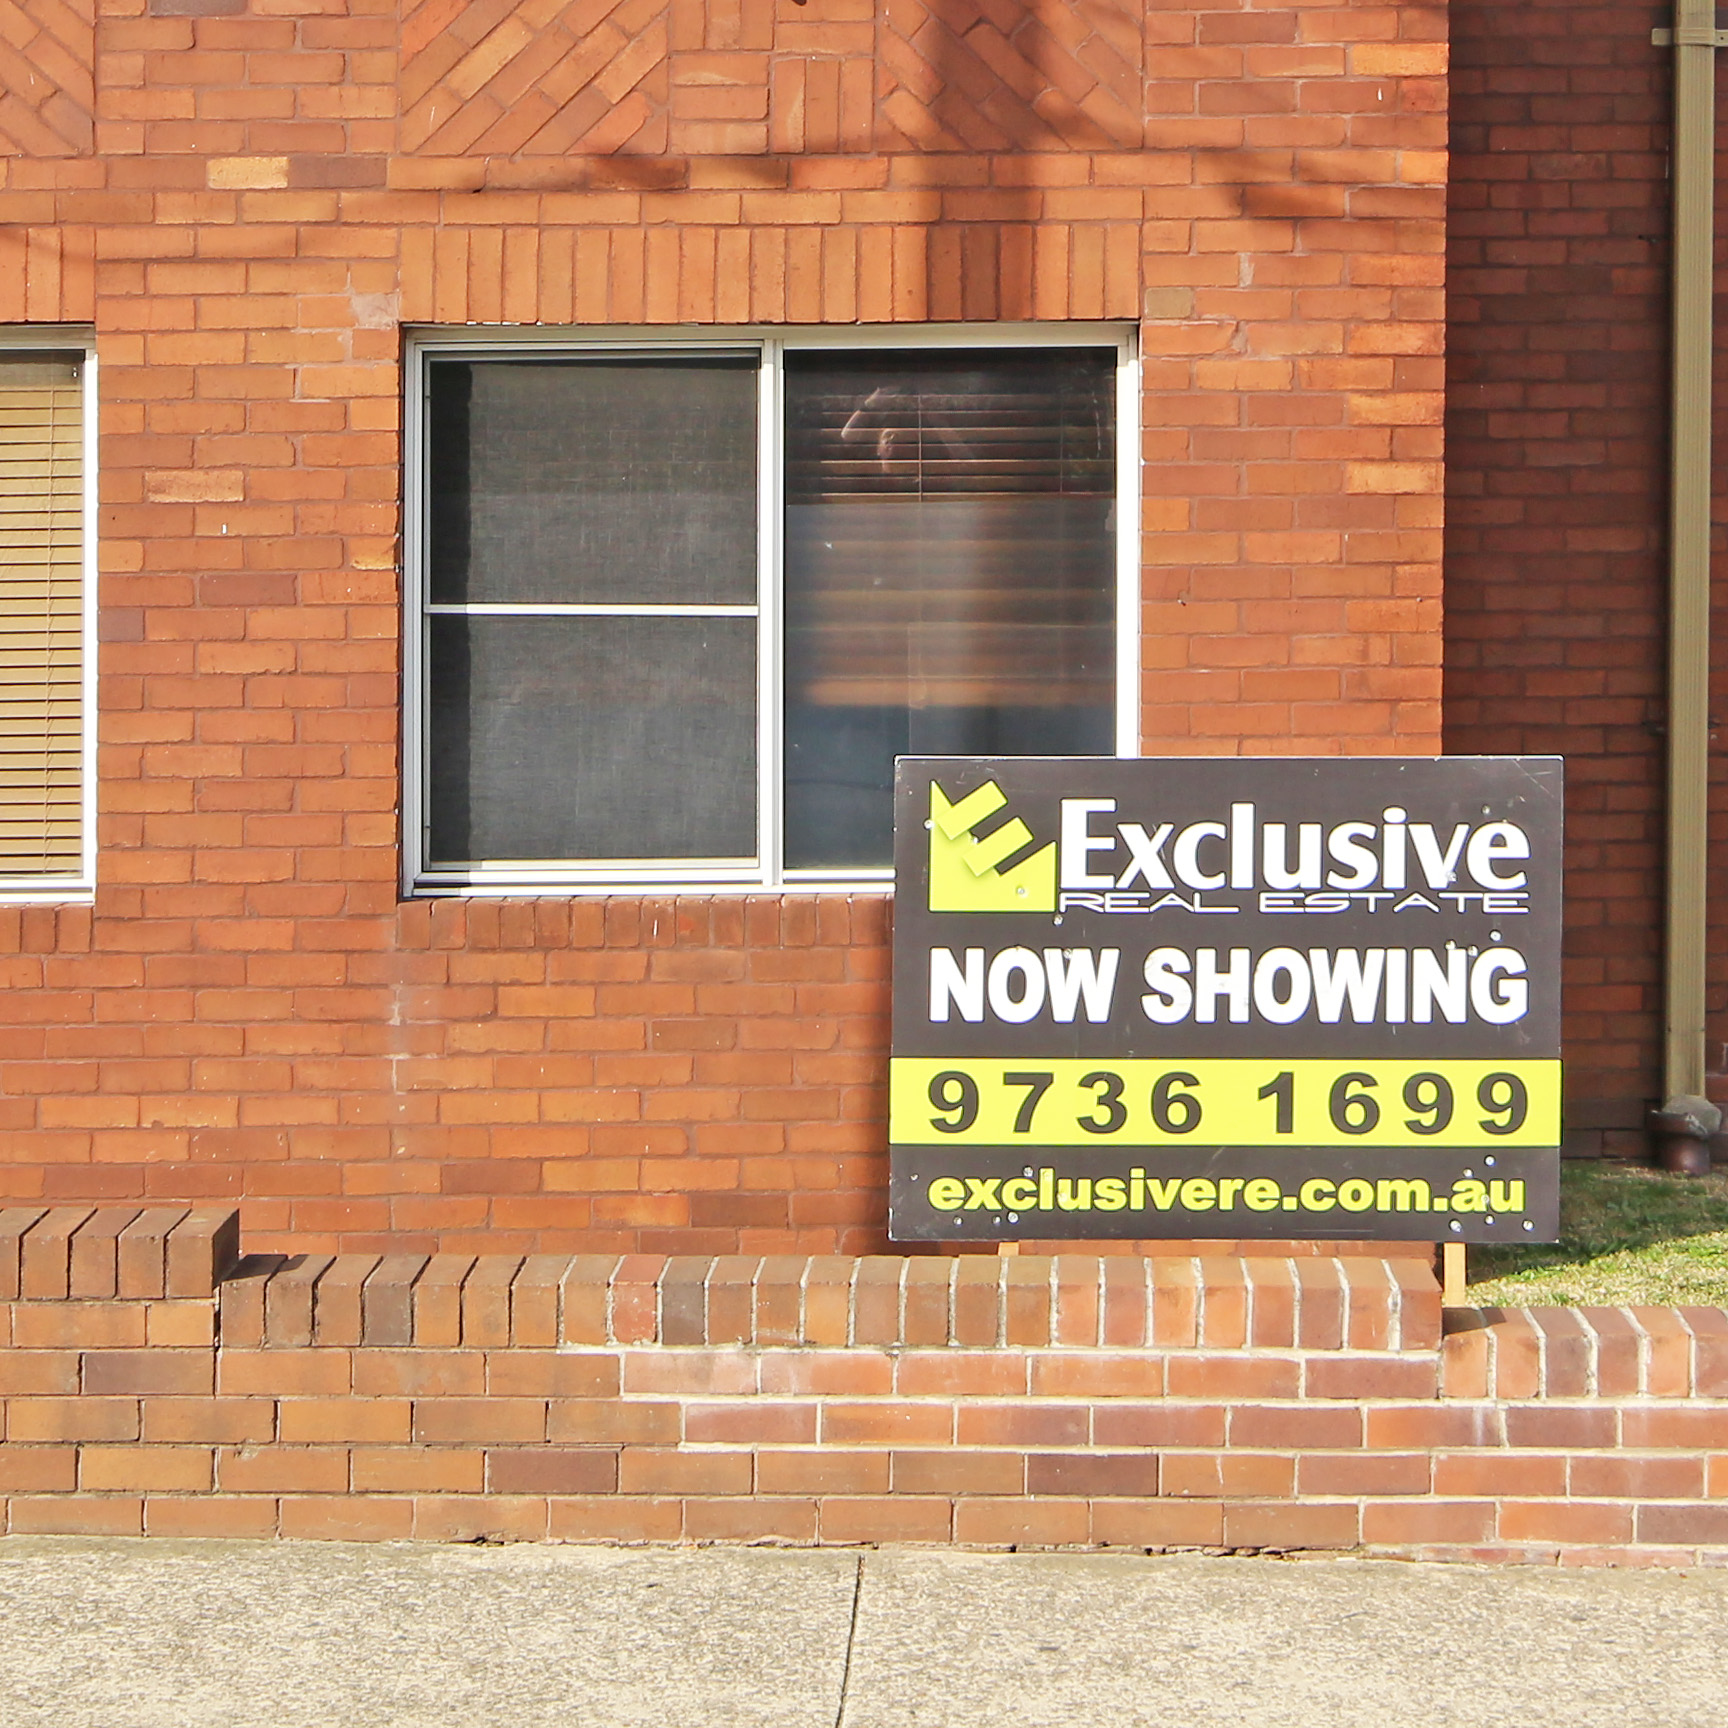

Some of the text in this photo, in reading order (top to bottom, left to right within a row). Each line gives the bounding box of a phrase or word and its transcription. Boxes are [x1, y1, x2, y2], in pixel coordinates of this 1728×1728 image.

[1060, 798, 1532, 890] Exclusive
[1059, 891, 1530, 914] REAL ESTATE
[928, 946, 1530, 1024] NOW SHOWING
[927, 1071, 1529, 1134] 9736 1699
[927, 1167, 1525, 1213] exclusivere.com.au
